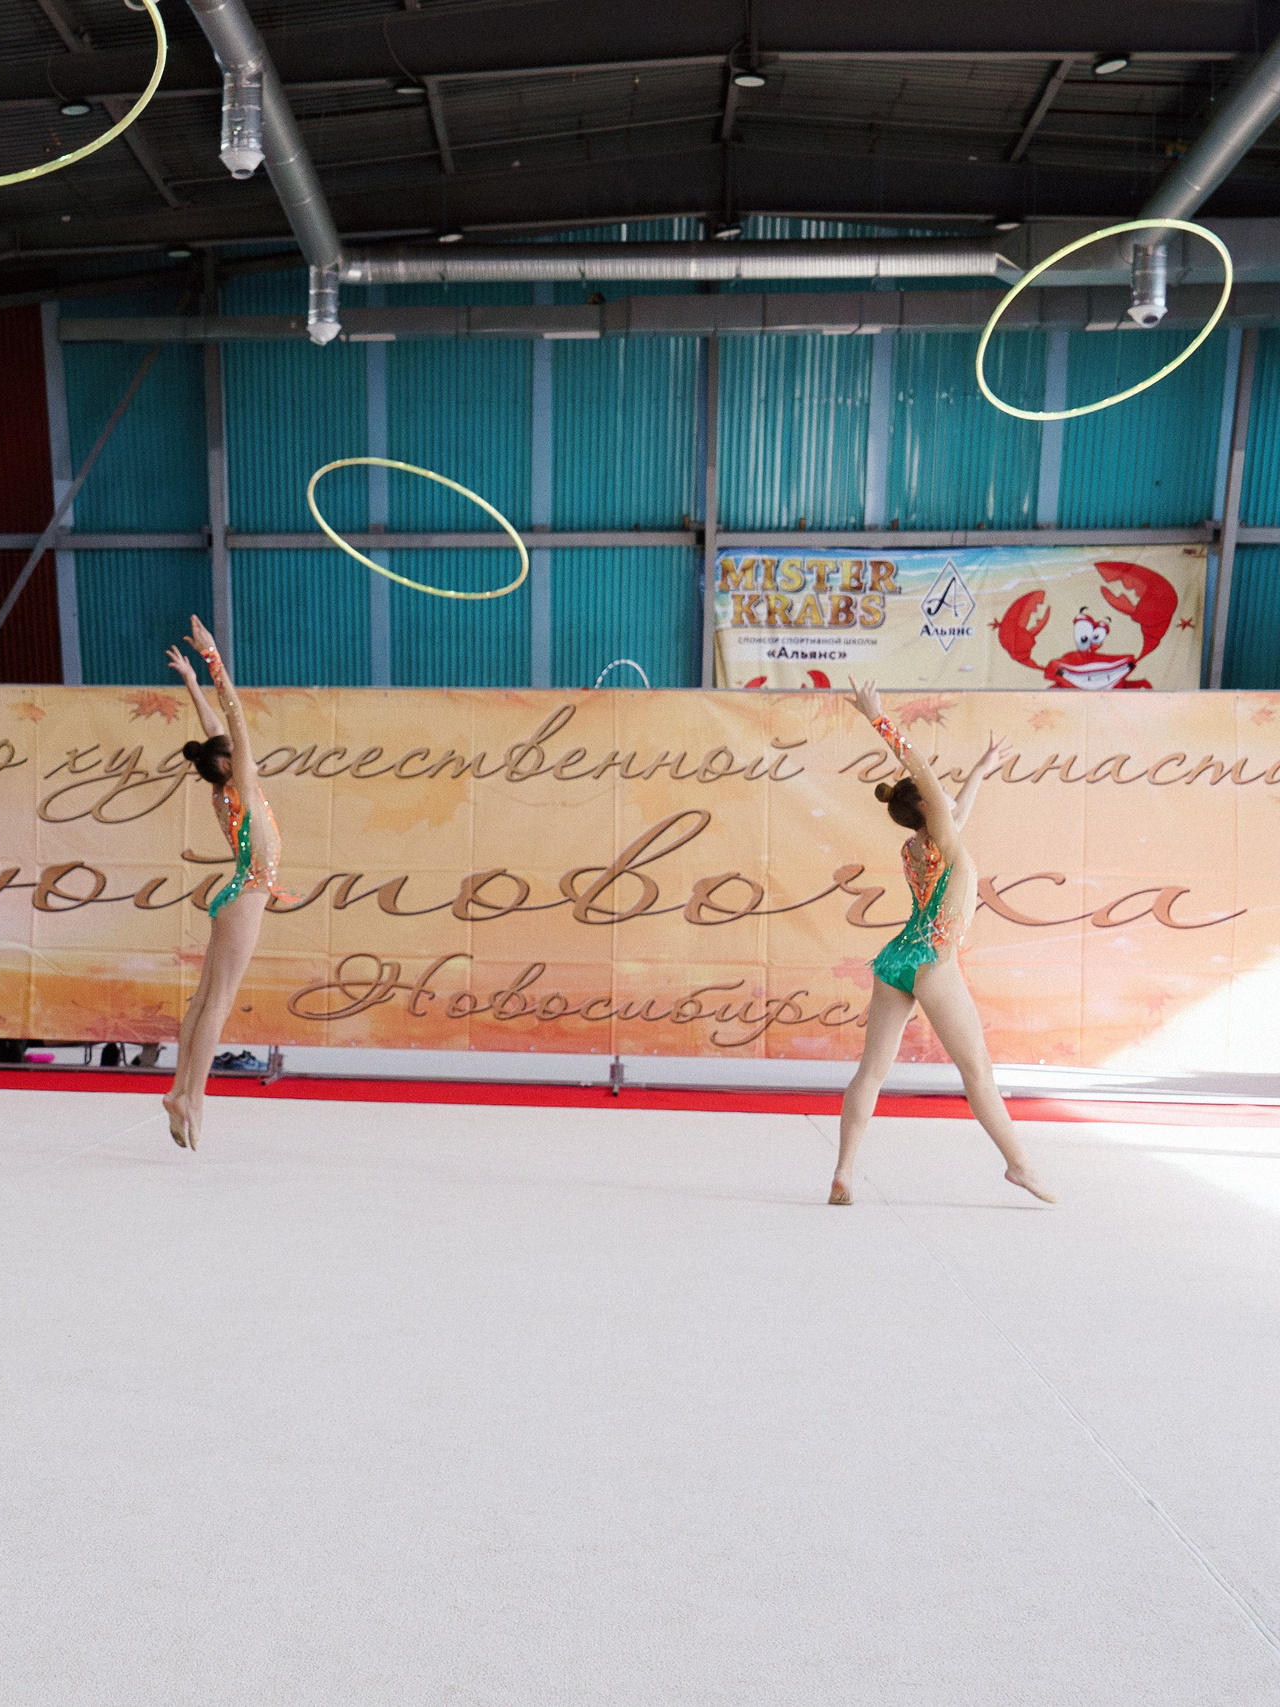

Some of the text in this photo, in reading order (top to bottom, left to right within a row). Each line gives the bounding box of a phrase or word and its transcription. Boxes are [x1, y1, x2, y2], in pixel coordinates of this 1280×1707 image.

[719, 558, 901, 594] MISTER
[730, 593, 885, 629] KRABS
[920, 624, 974, 638] Альянс
[767, 646, 847, 660] «Альянс»
[38, 703, 808, 824] худжественной
[287, 953, 918, 1048] Новосибирс
